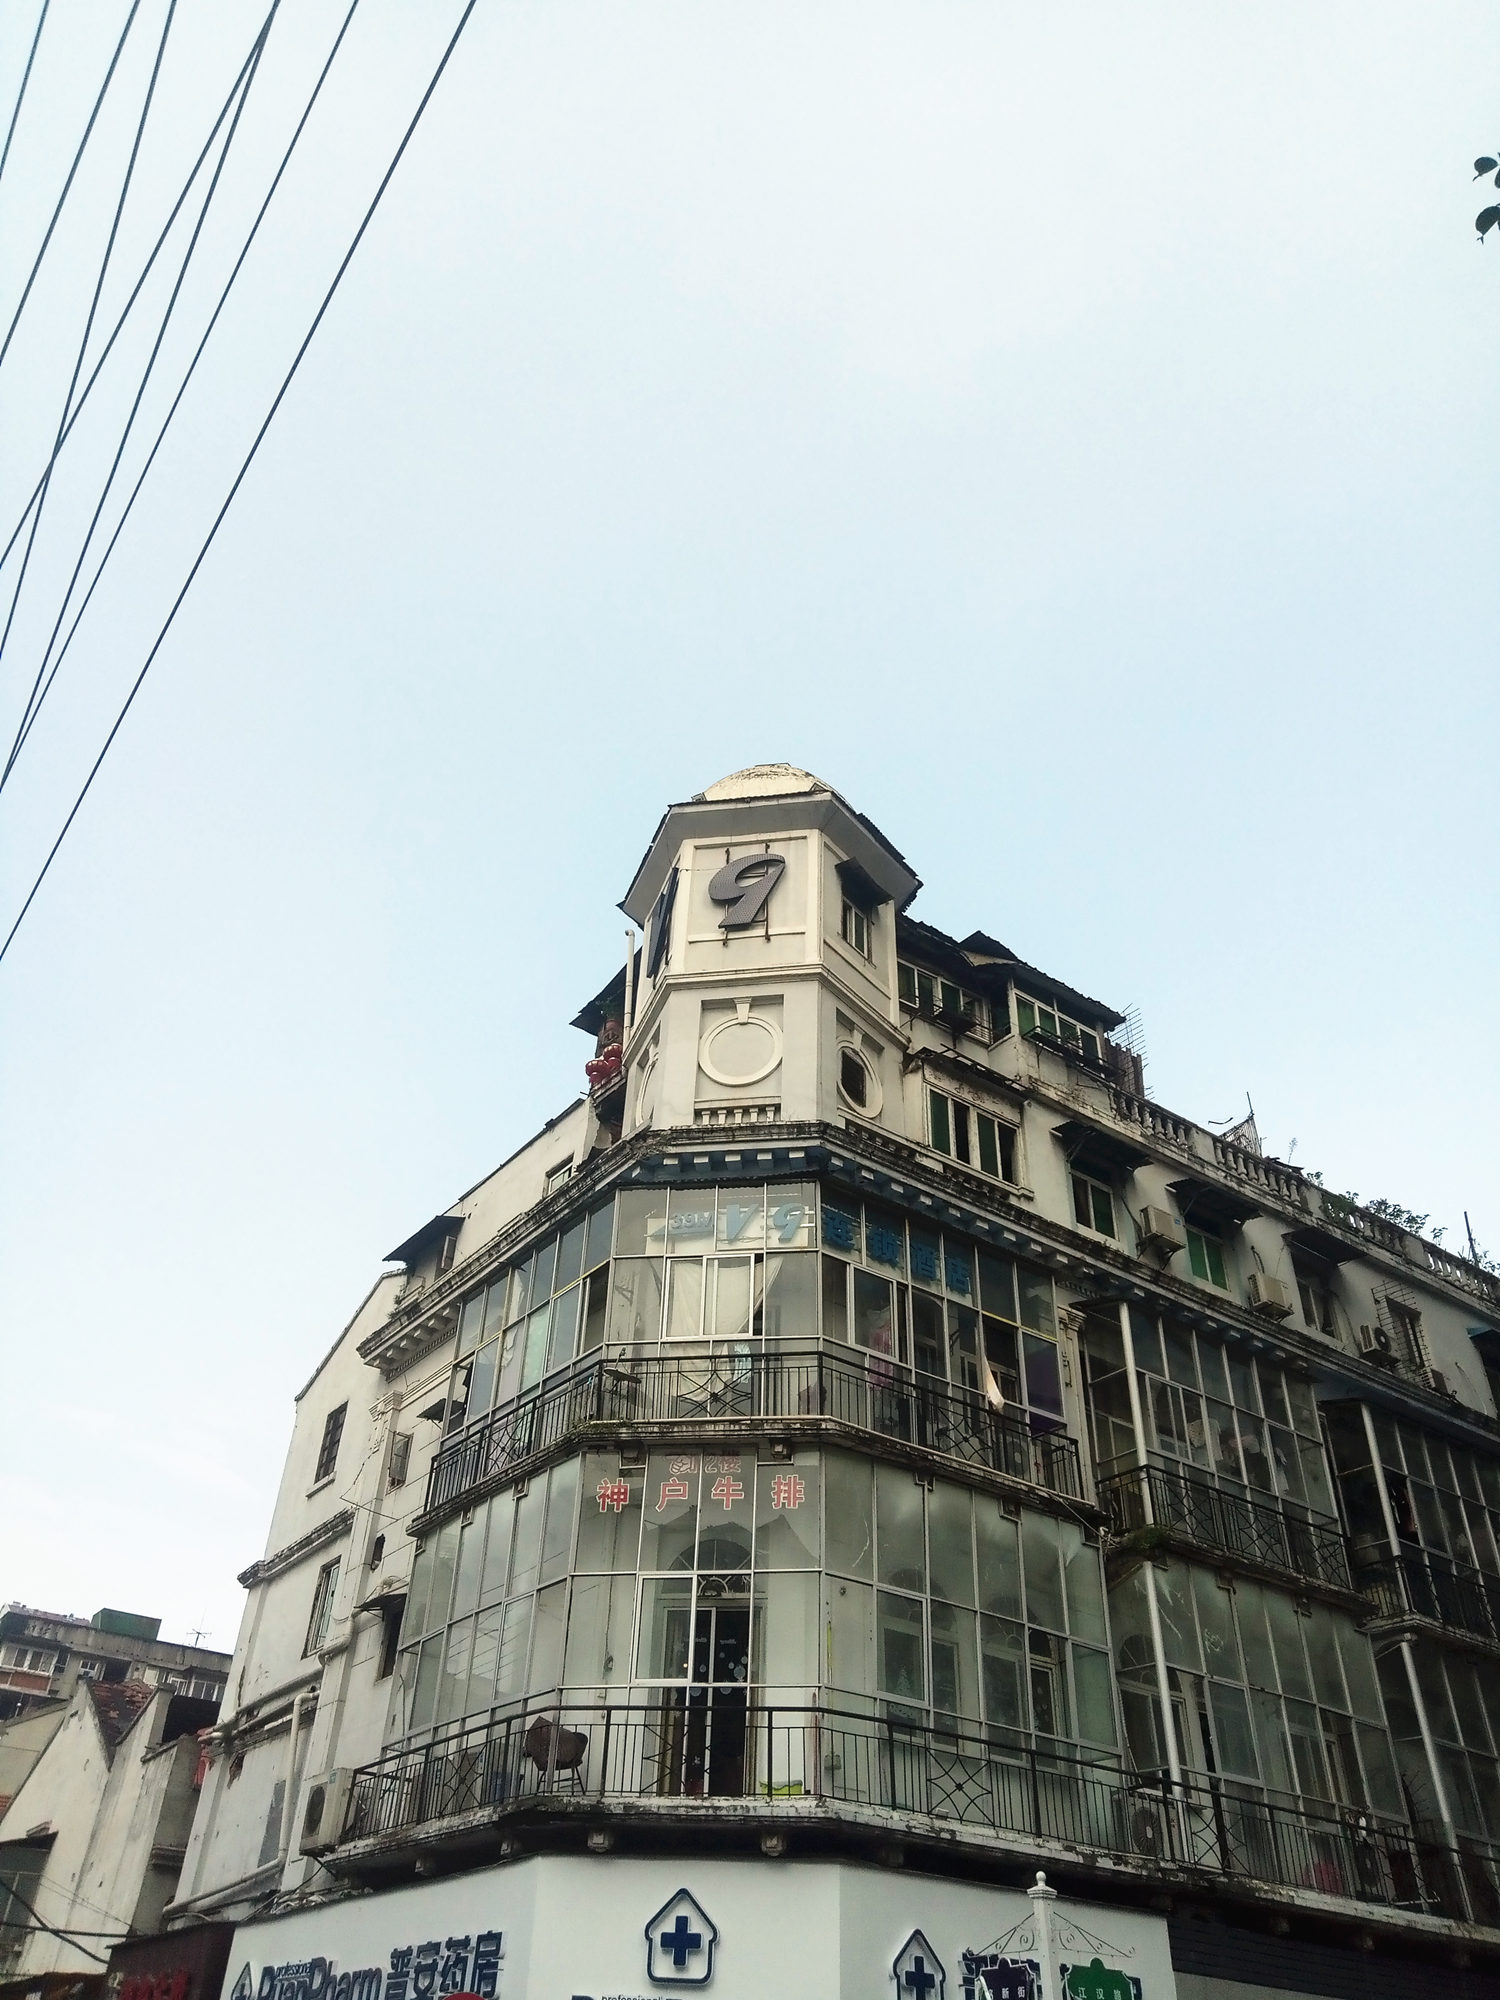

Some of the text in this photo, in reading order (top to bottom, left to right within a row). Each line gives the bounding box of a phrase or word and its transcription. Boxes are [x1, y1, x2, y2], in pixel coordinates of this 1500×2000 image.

[708, 853, 785, 930] 9
[596, 1474, 805, 1512] 神户牛排
[275, 1959, 312, 1979] professiona
[385, 1930, 503, 2000] 普安药房
[1078, 1986, 1121, 2000] 江汉路
